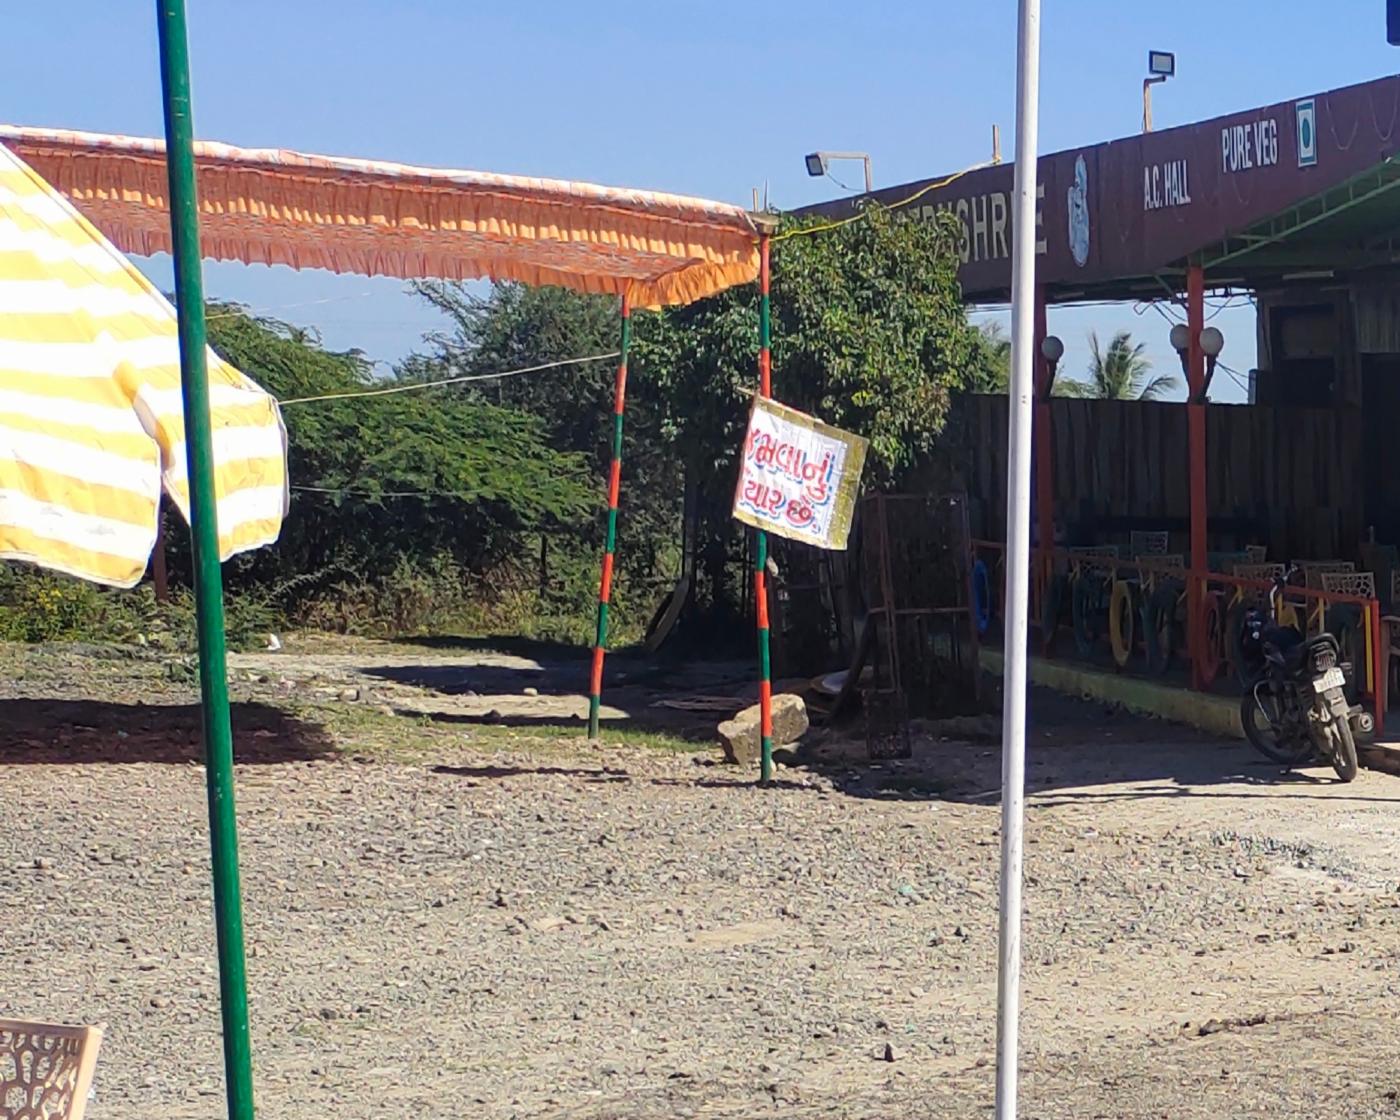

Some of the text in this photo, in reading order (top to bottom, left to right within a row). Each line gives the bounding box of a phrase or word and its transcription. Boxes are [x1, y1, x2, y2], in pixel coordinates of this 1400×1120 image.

[1221, 118, 1278, 174] PURE VEG
[1143, 159, 1192, 211] A.C. HALL
